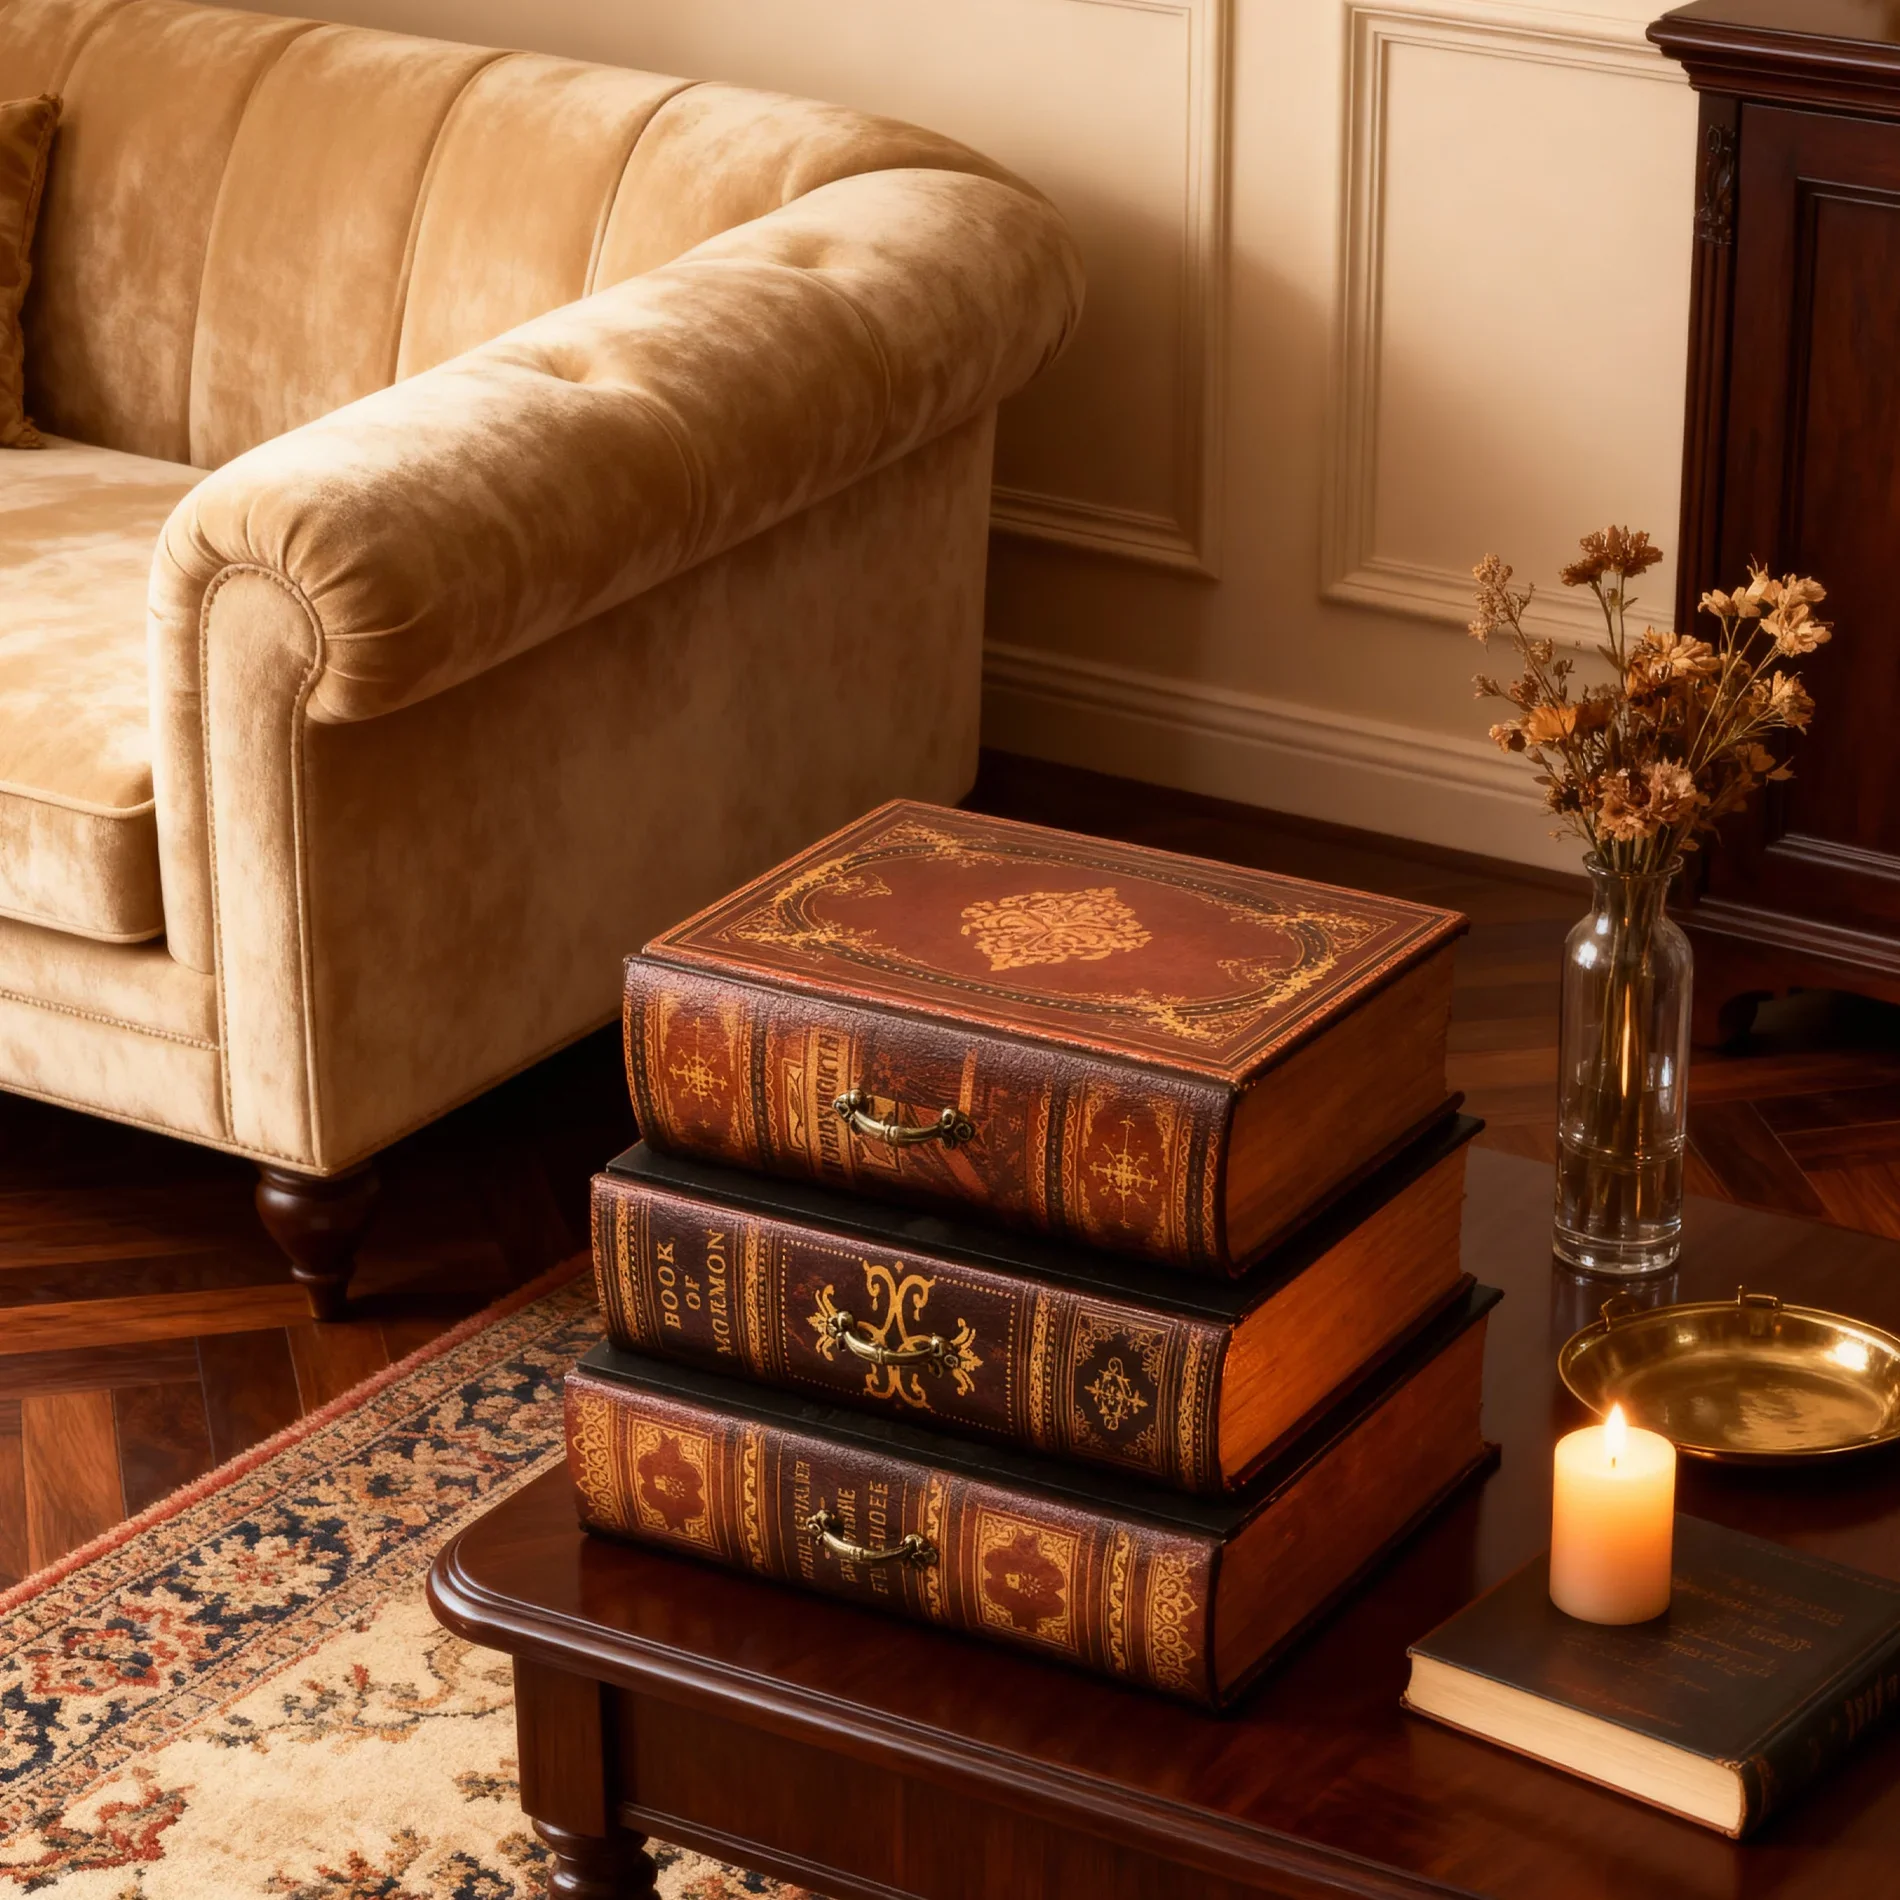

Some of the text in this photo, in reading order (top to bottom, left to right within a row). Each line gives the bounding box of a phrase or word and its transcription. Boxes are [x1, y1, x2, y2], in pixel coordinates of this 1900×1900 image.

[656, 1240, 682, 1331] BOOK
[684, 1274, 701, 1311] OF
[705, 1228, 733, 1356] MORMON
